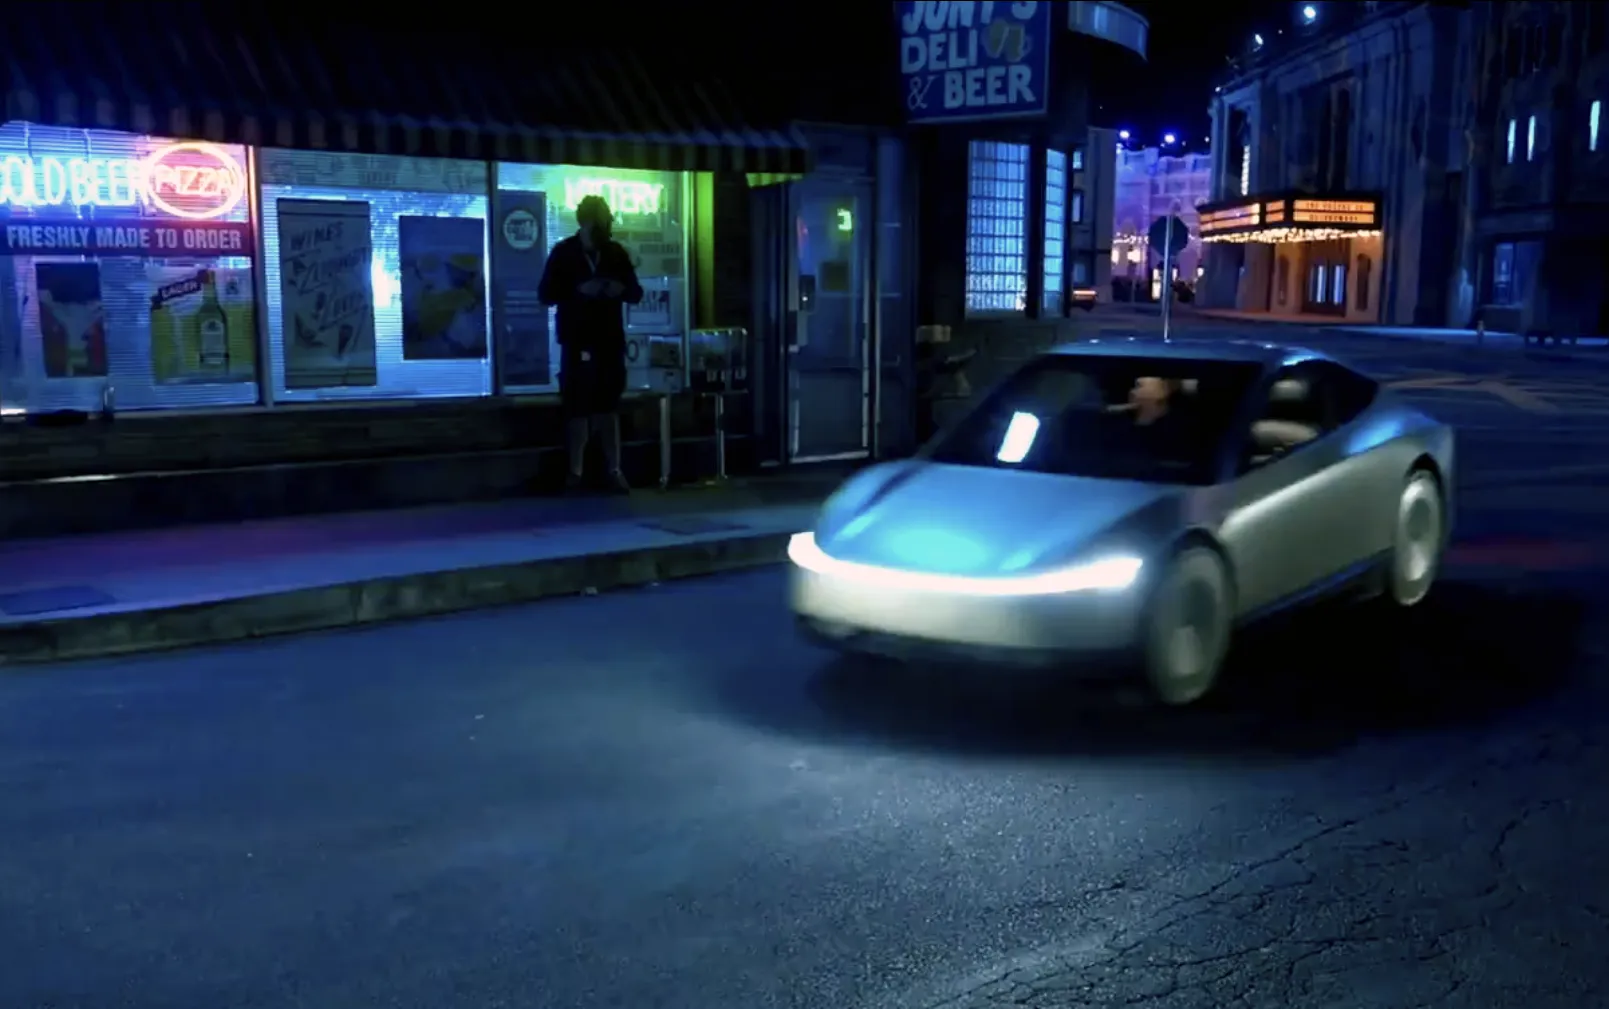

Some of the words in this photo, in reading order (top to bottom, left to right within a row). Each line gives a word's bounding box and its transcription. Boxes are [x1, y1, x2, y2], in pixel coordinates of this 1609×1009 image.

[901, 29, 978, 74] DELI
[907, 76, 936, 110] &
[944, 65, 1036, 108] BEER
[68, 157, 149, 207] BEER
[155, 164, 233, 198] PIZZA
[6, 224, 90, 248] FRESHLY
[95, 226, 150, 249] MADE
[155, 228, 178, 249] TO
[183, 228, 242, 250] ORDER
